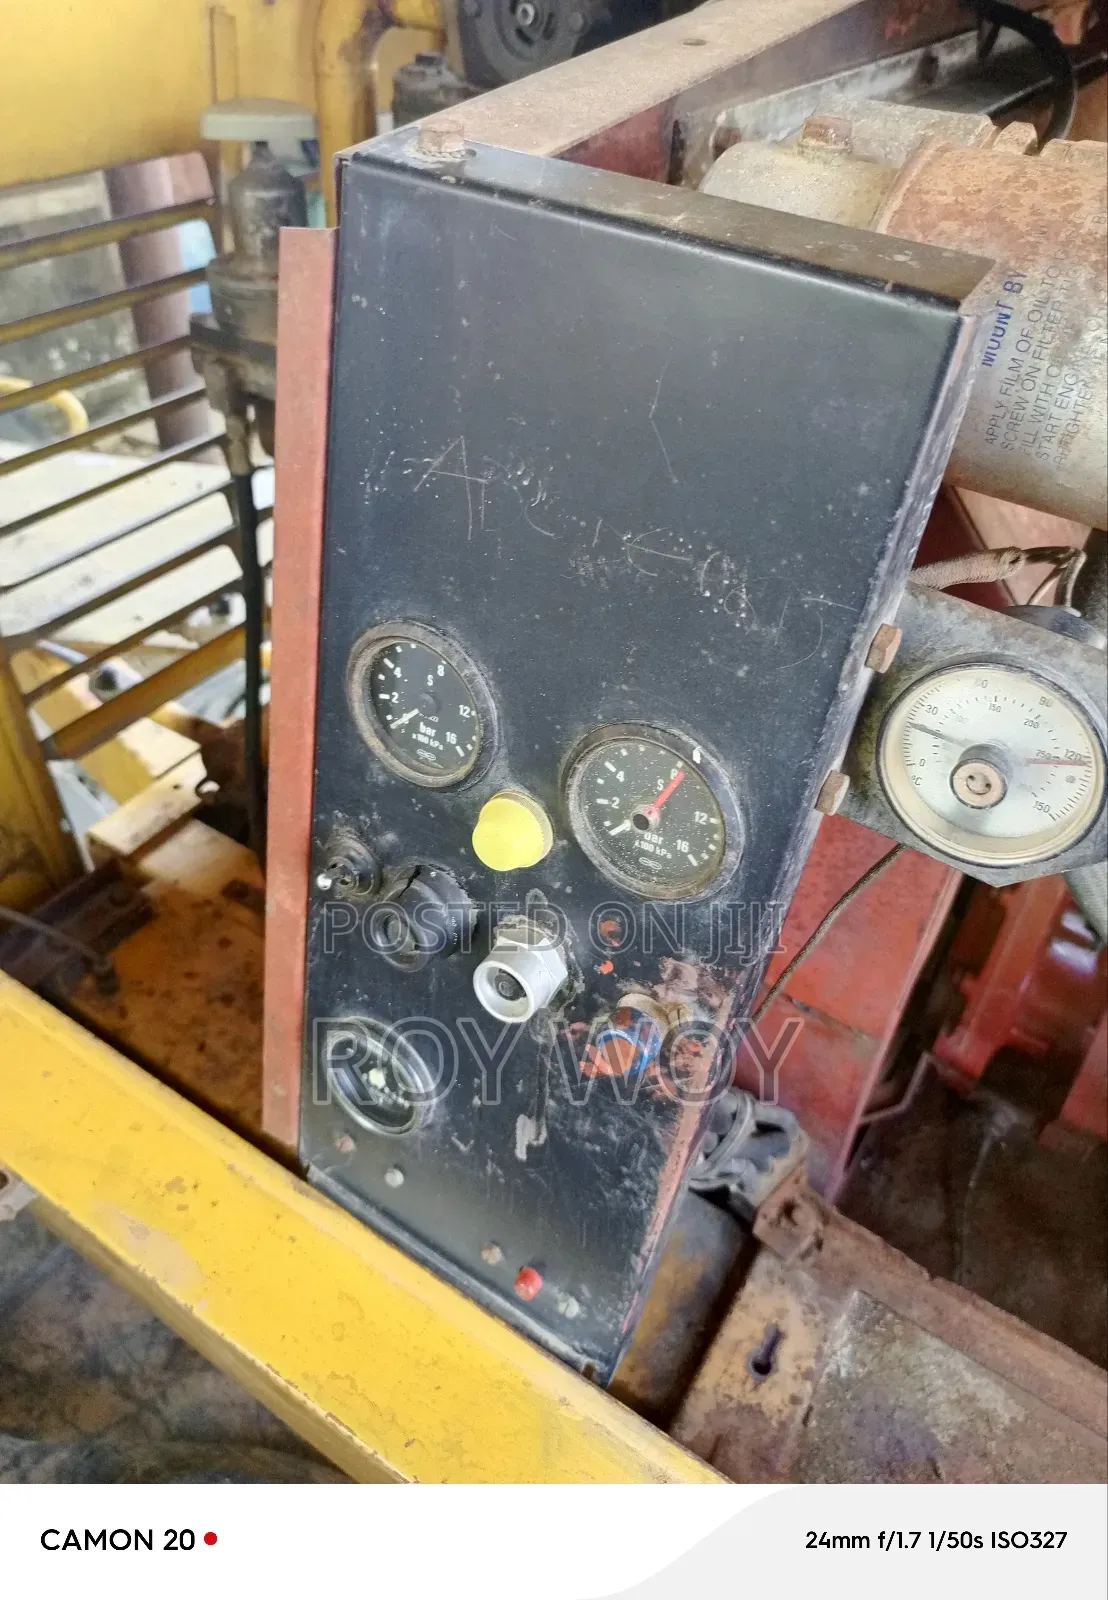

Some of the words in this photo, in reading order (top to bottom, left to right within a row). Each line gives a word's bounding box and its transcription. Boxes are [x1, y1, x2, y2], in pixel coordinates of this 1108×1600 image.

[1002, 269, 1028, 295] BY
[984, 400, 1008, 446] APPLY
[1000, 357, 1024, 397] FILM
[1015, 326, 1034, 353] OF
[1027, 294, 1050, 323] OIL
[1041, 265, 1061, 289] TO
[1001, 397, 1030, 452] SCREW
[1021, 365, 1041, 392] ON
[1032, 299, 1065, 362] FILTER
[1027, 381, 1055, 424] WITH
[1035, 412, 1062, 461] START
[393, 667, 402, 679] 4
[437, 664, 445, 677] 8
[391, 692, 400, 704] 2
[458, 704, 472, 719] 12
[925, 703, 940, 716] 30
[988, 702, 1002, 713] 150
[419, 721, 437, 738] bar
[1023, 717, 1040, 730] 200
[445, 731, 458, 745] 16
[1035, 749, 1052, 761] 250
[1064, 748, 1083, 761] 120
[918, 758, 927, 768] 0
[616, 771, 625, 783] 4
[611, 796, 620, 809] 2
[1032, 800, 1052, 814] 150
[693, 811, 708, 826] 12
[655, 846, 673, 859] kPa
[675, 839, 690, 853] 16
